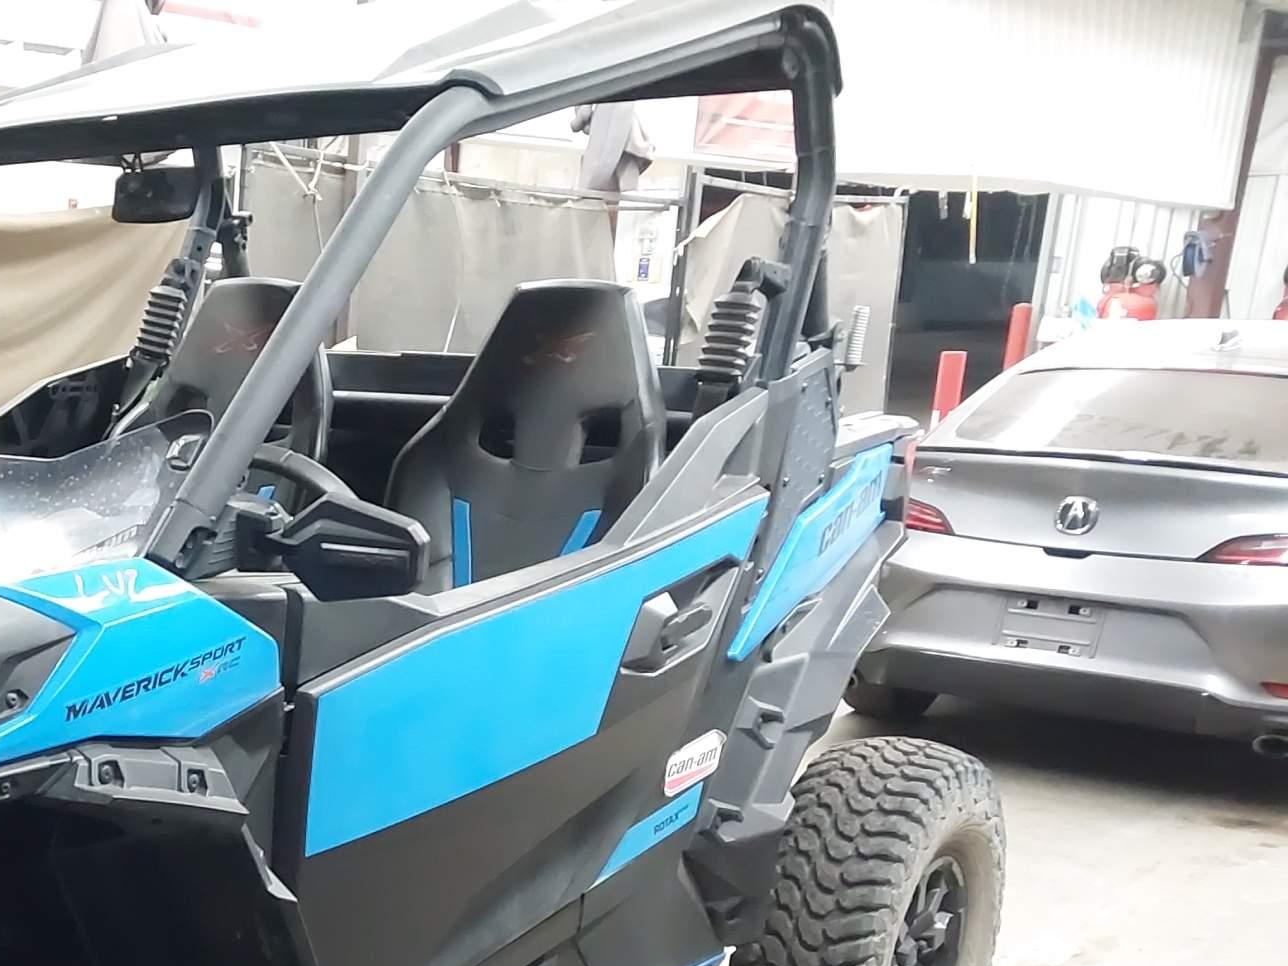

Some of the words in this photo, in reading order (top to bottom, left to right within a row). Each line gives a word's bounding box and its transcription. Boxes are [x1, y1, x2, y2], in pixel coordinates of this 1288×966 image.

[64, 658, 191, 722] MAVERICK
[187, 636, 247, 672] SPORT
[667, 746, 719, 778] can-am
